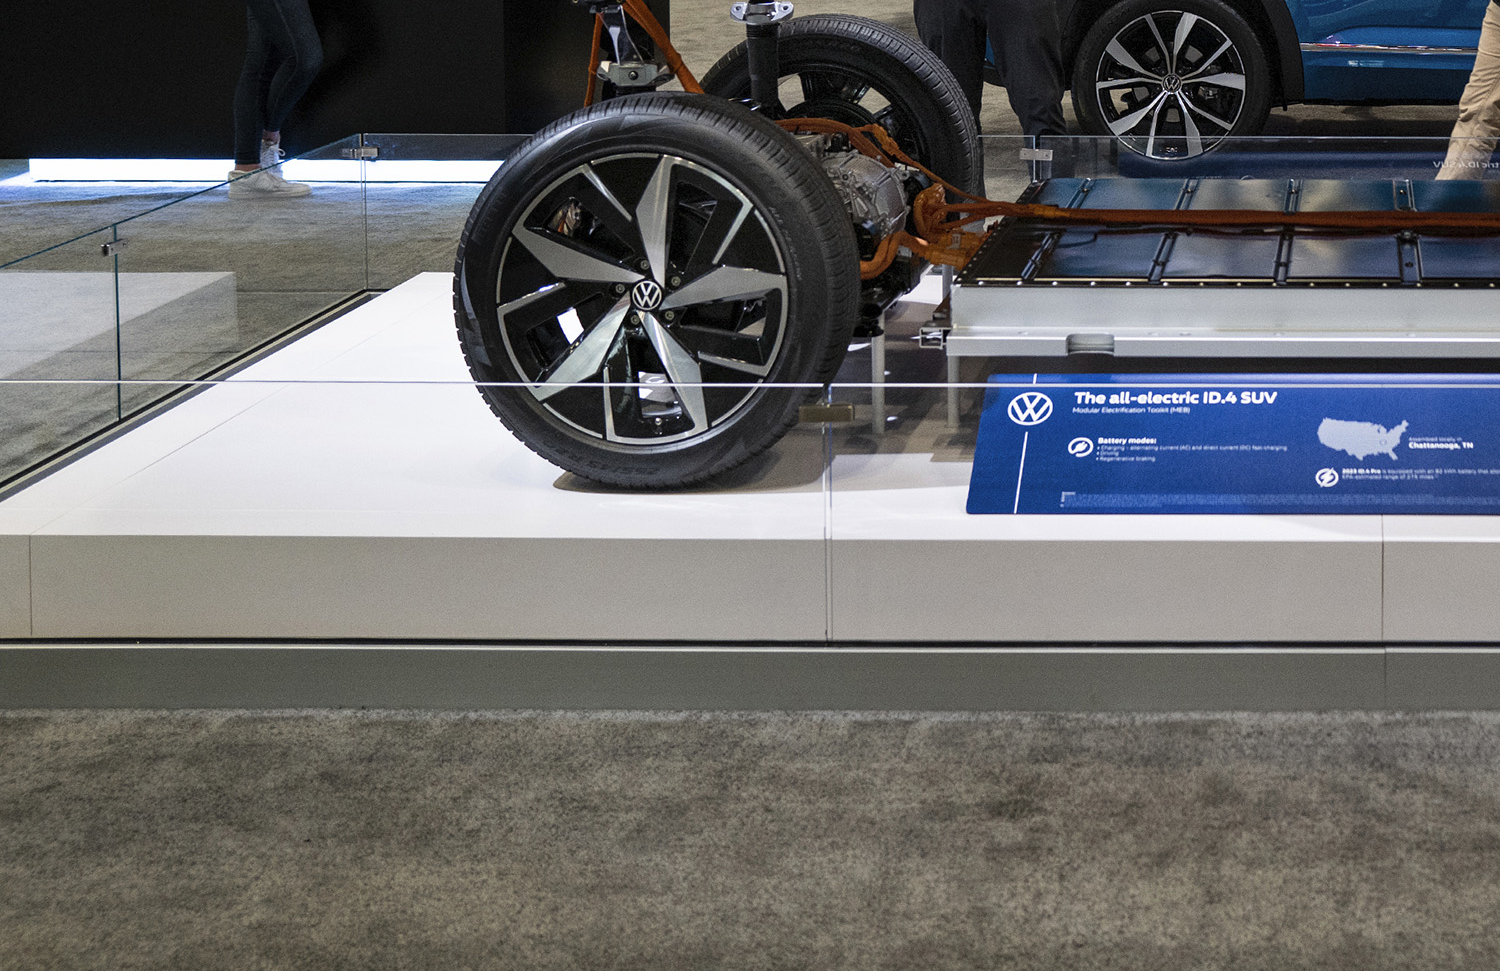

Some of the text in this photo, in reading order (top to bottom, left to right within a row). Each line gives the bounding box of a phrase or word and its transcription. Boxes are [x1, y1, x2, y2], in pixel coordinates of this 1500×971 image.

[1074, 391, 1278, 404] The all-electric ID.4 SUV
[1098, 437, 1127, 445] Battery
[1408, 442, 1460, 450] Chattanooga,
